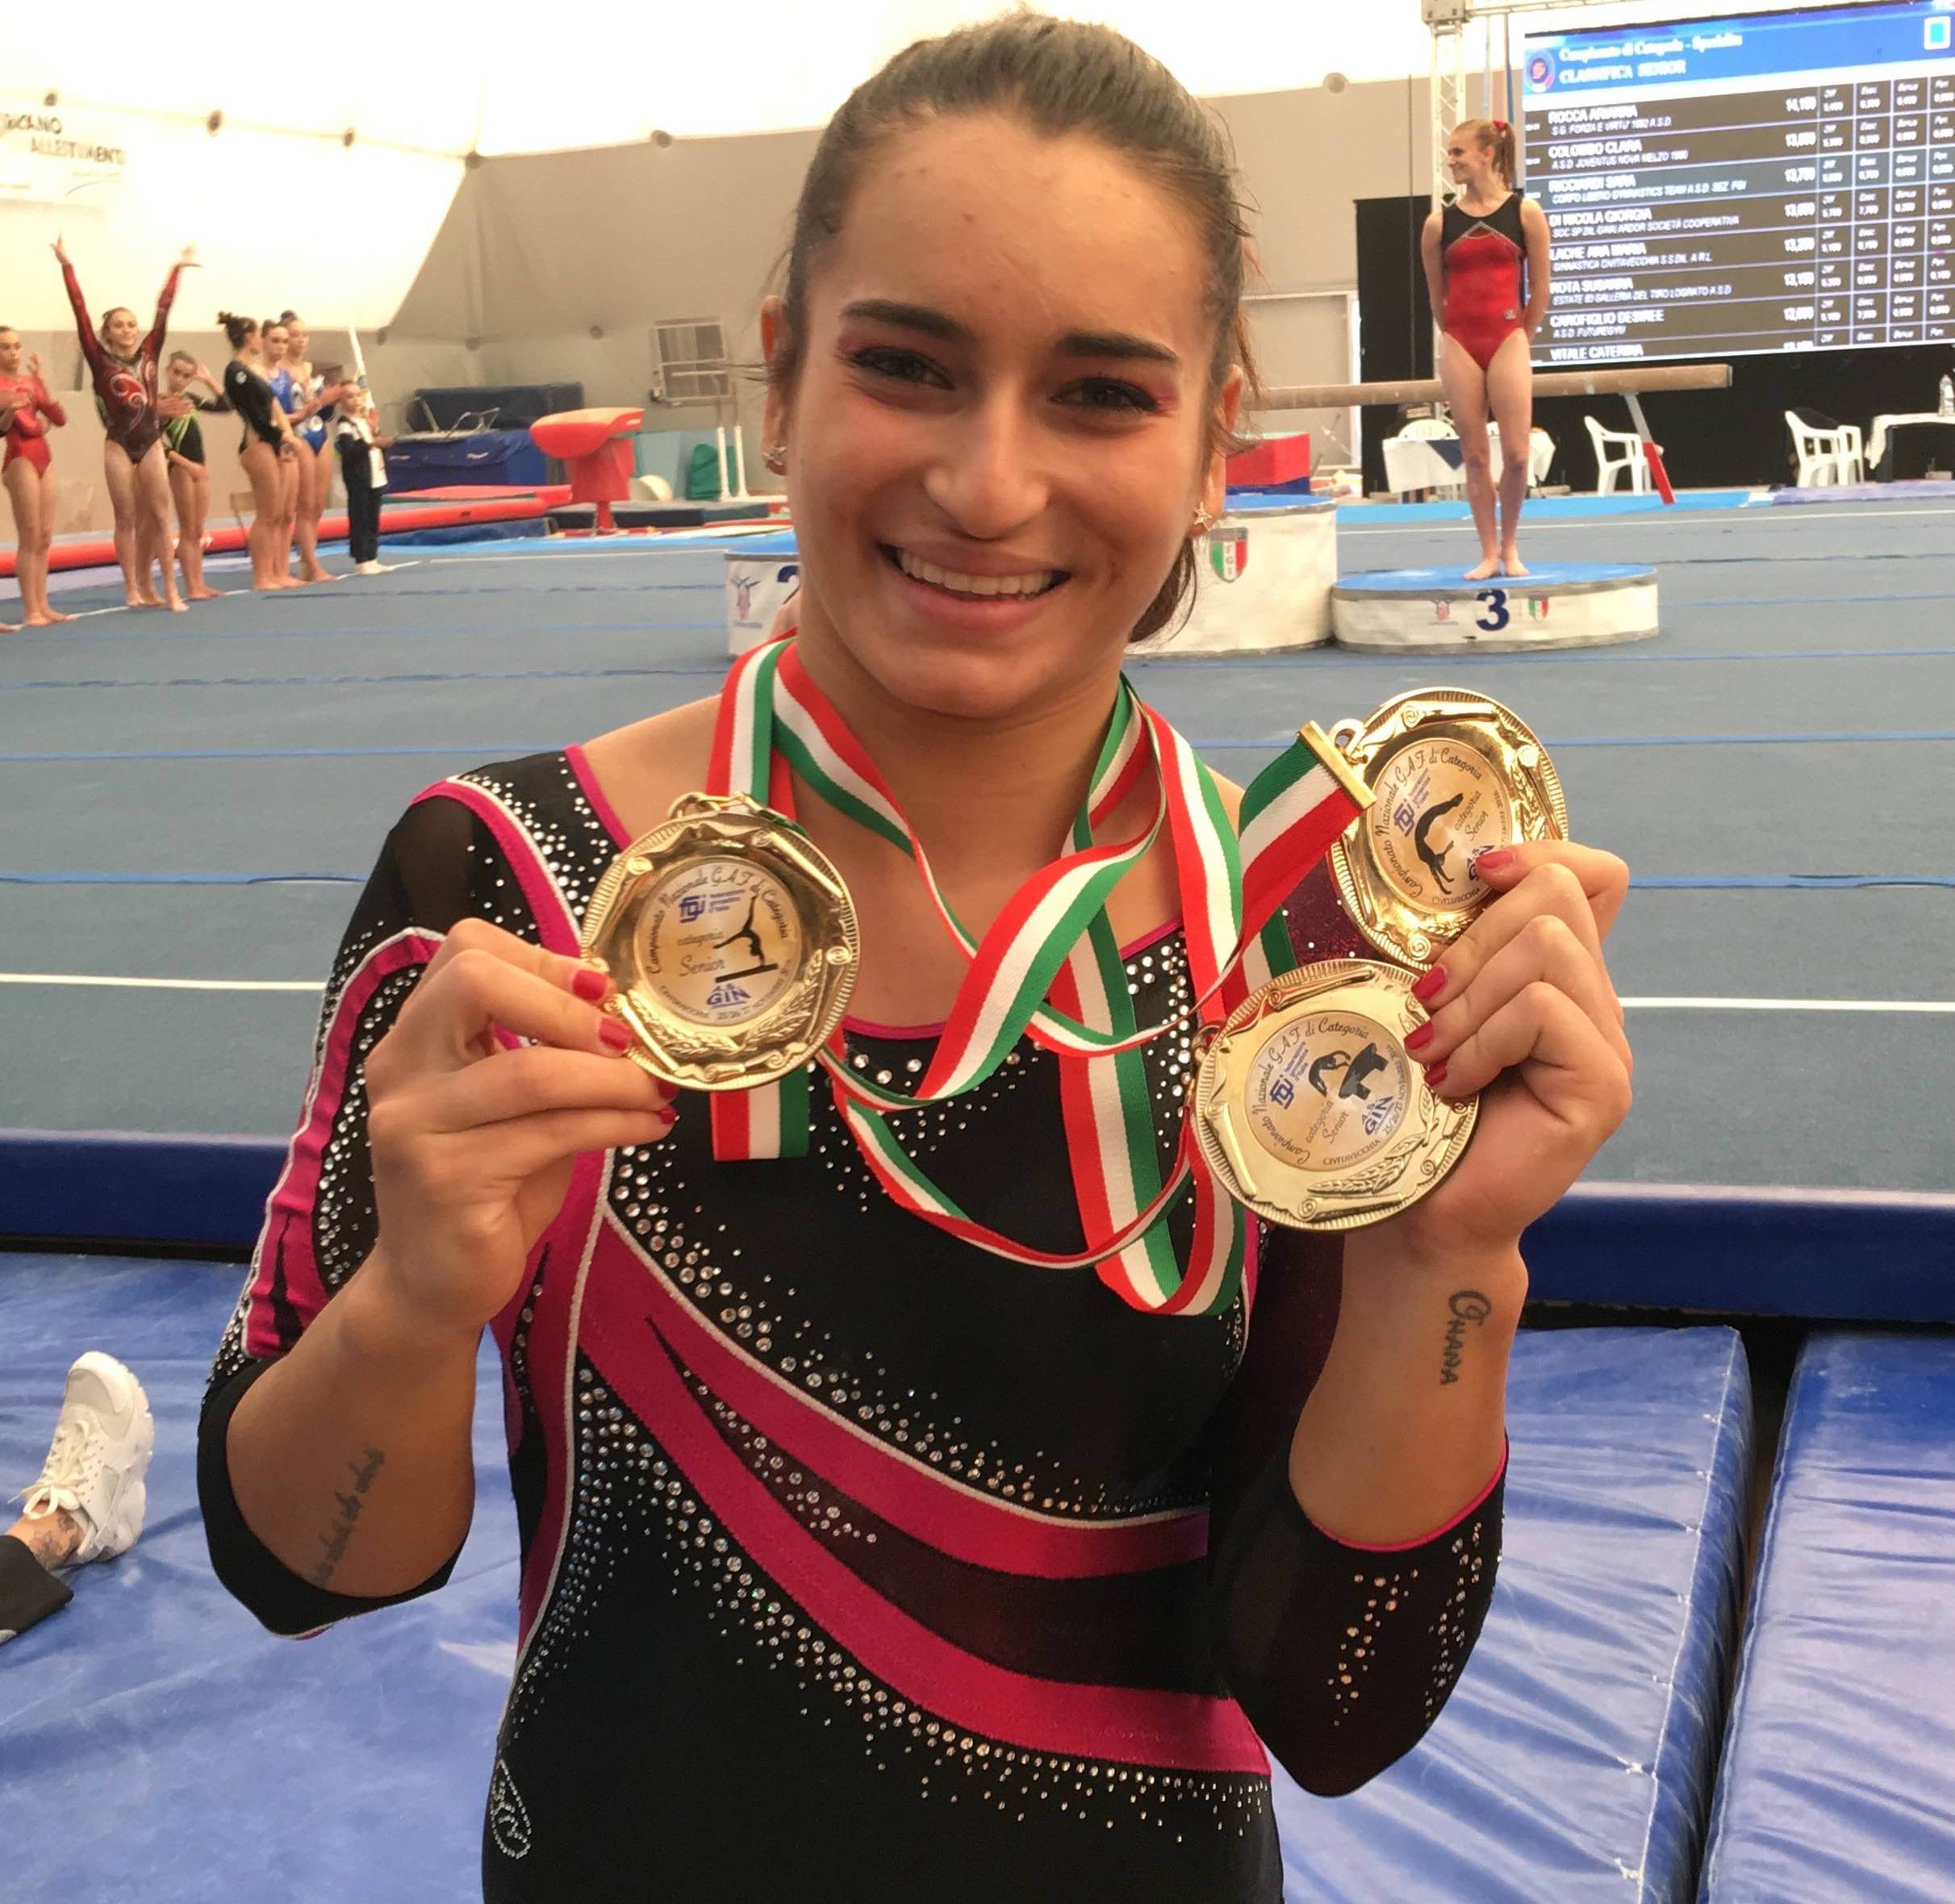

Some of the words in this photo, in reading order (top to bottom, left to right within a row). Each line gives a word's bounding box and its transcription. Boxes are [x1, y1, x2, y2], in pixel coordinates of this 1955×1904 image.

[1476, 588, 1510, 632] 3
[1429, 747, 1438, 764] di
[1441, 747, 1482, 780] Categoria
[1375, 781, 1399, 836] Nazionale
[1454, 790, 1482, 831] categoria
[1464, 811, 1489, 841] Senior
[1384, 840, 1422, 897] Campionato
[706, 989, 751, 1006] GIN
[1262, 1117, 1311, 1165] Campionato
[1305, 1021, 1316, 1038] di
[1318, 1017, 1369, 1039] Categoria
[1305, 1100, 1334, 1143] categoria
[1323, 1111, 1349, 1144] Senior
[1364, 1096, 1394, 1136] GIN
